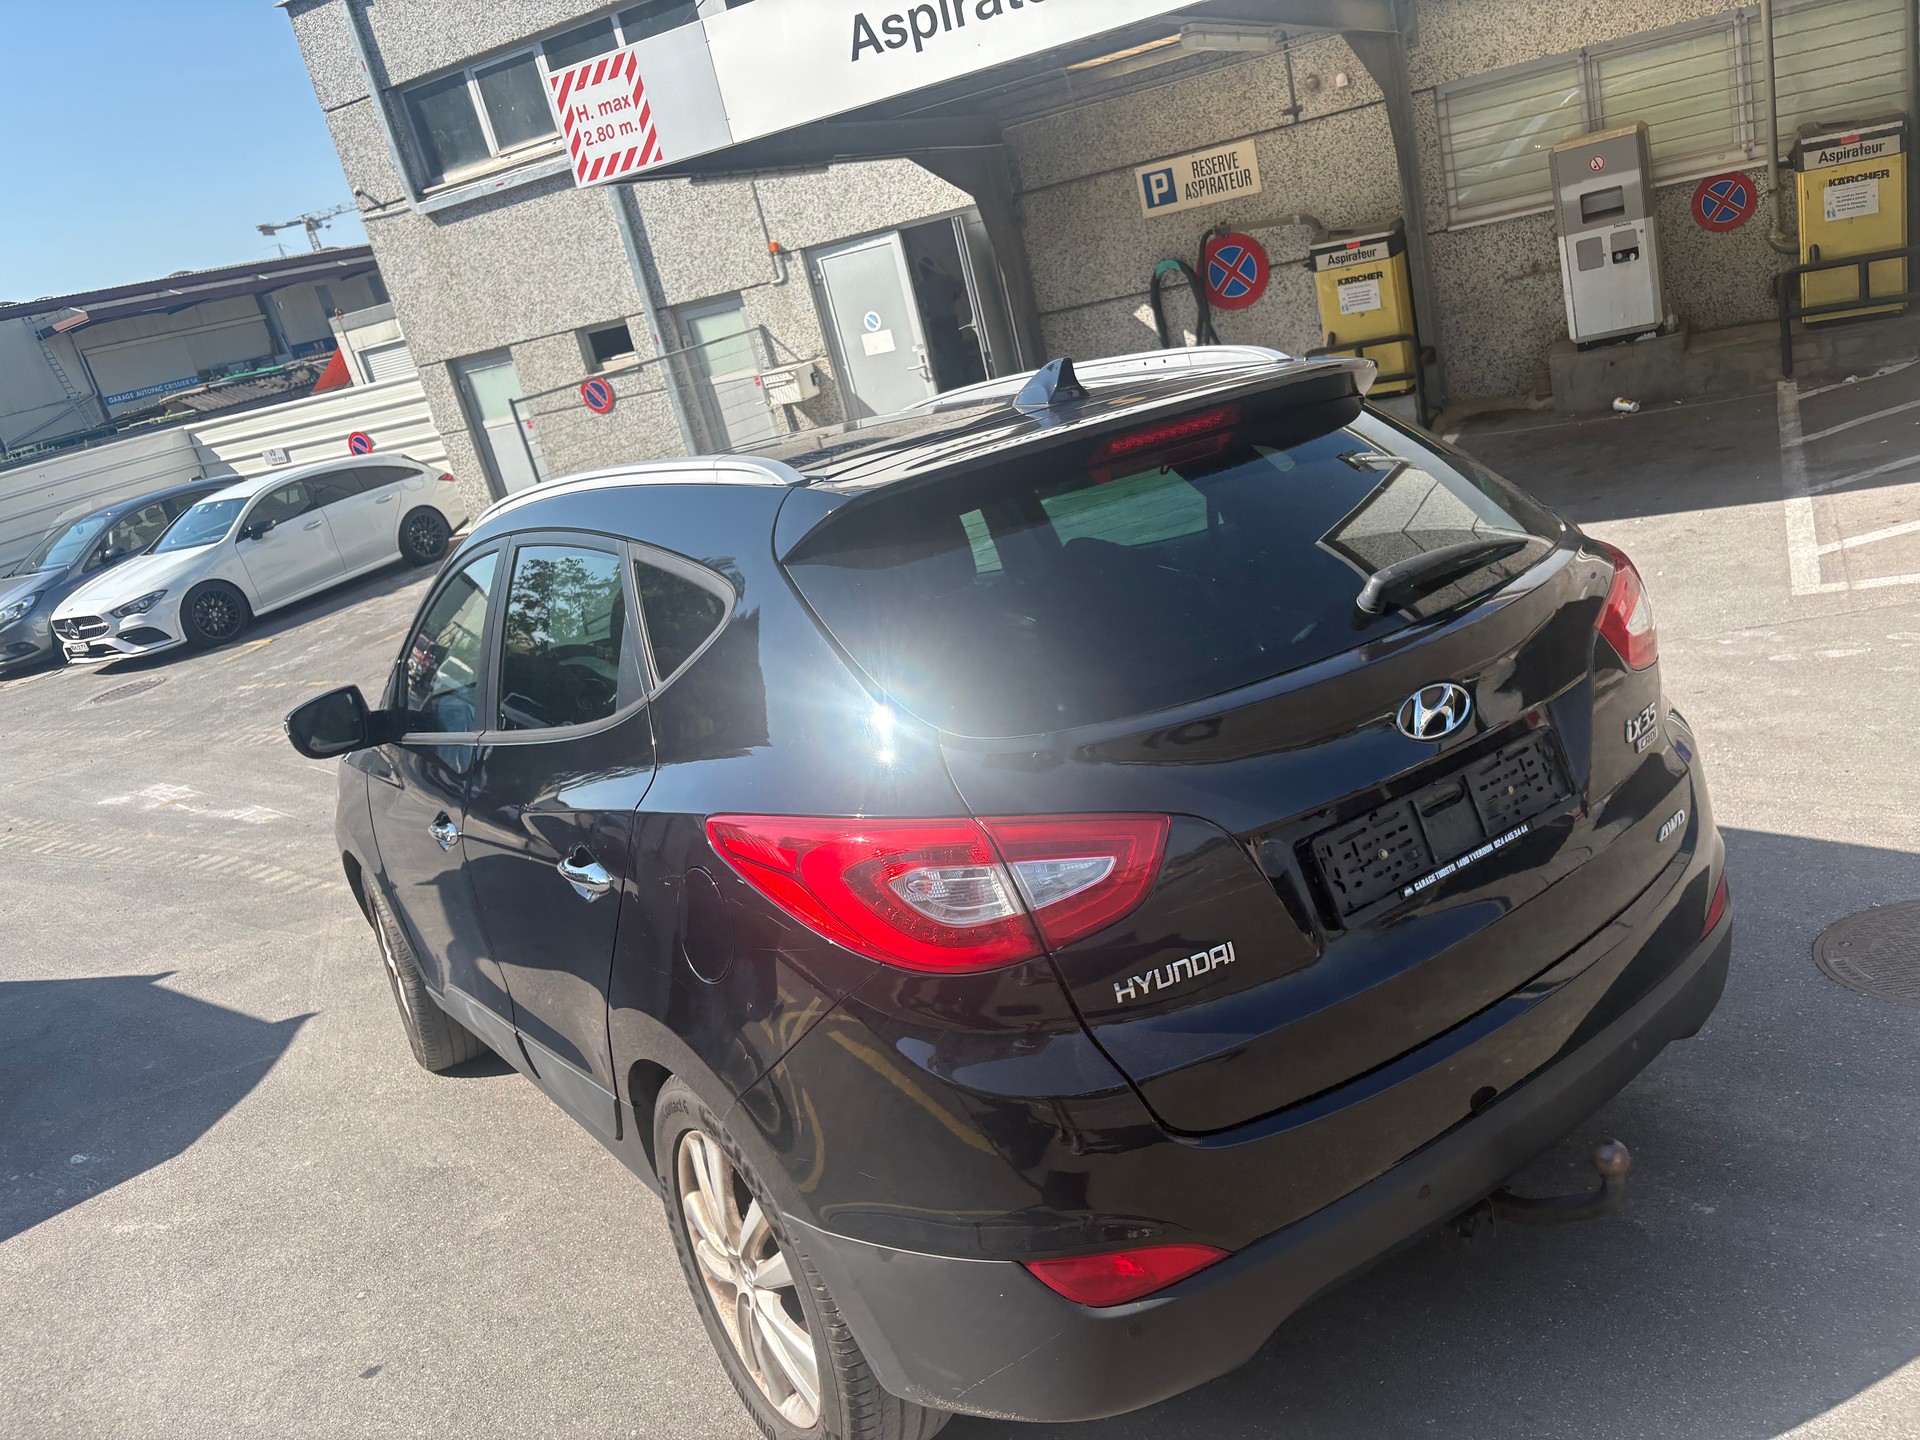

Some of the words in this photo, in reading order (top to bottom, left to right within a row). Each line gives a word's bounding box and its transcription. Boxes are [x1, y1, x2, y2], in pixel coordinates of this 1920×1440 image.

[851, 0, 1044, 62] Aspira
[576, 104, 594, 123] H.
[598, 94, 631, 117] max
[583, 124, 615, 147] 2.80
[619, 121, 638, 136] m.
[1191, 151, 1240, 179] RESERVE
[1818, 142, 1885, 164] Aspirateur
[1149, 172, 1170, 205] P
[1185, 168, 1252, 200] ASPIRATEUR
[1327, 248, 1377, 266] Aspirateur
[108, 393, 134, 404] GARAGE
[1658, 809, 1685, 842] AWD
[1414, 875, 1437, 891] GARAGE
[1456, 855, 1470, 868] 1400
[1469, 843, 1494, 862] YVERDON
[1493, 837, 1505, 849] 024
[1504, 831, 1515, 842] 445
[1514, 828, 1521, 838] 34
[1521, 824, 1529, 834] 44
[1113, 941, 1236, 1004] HYUNDAI
